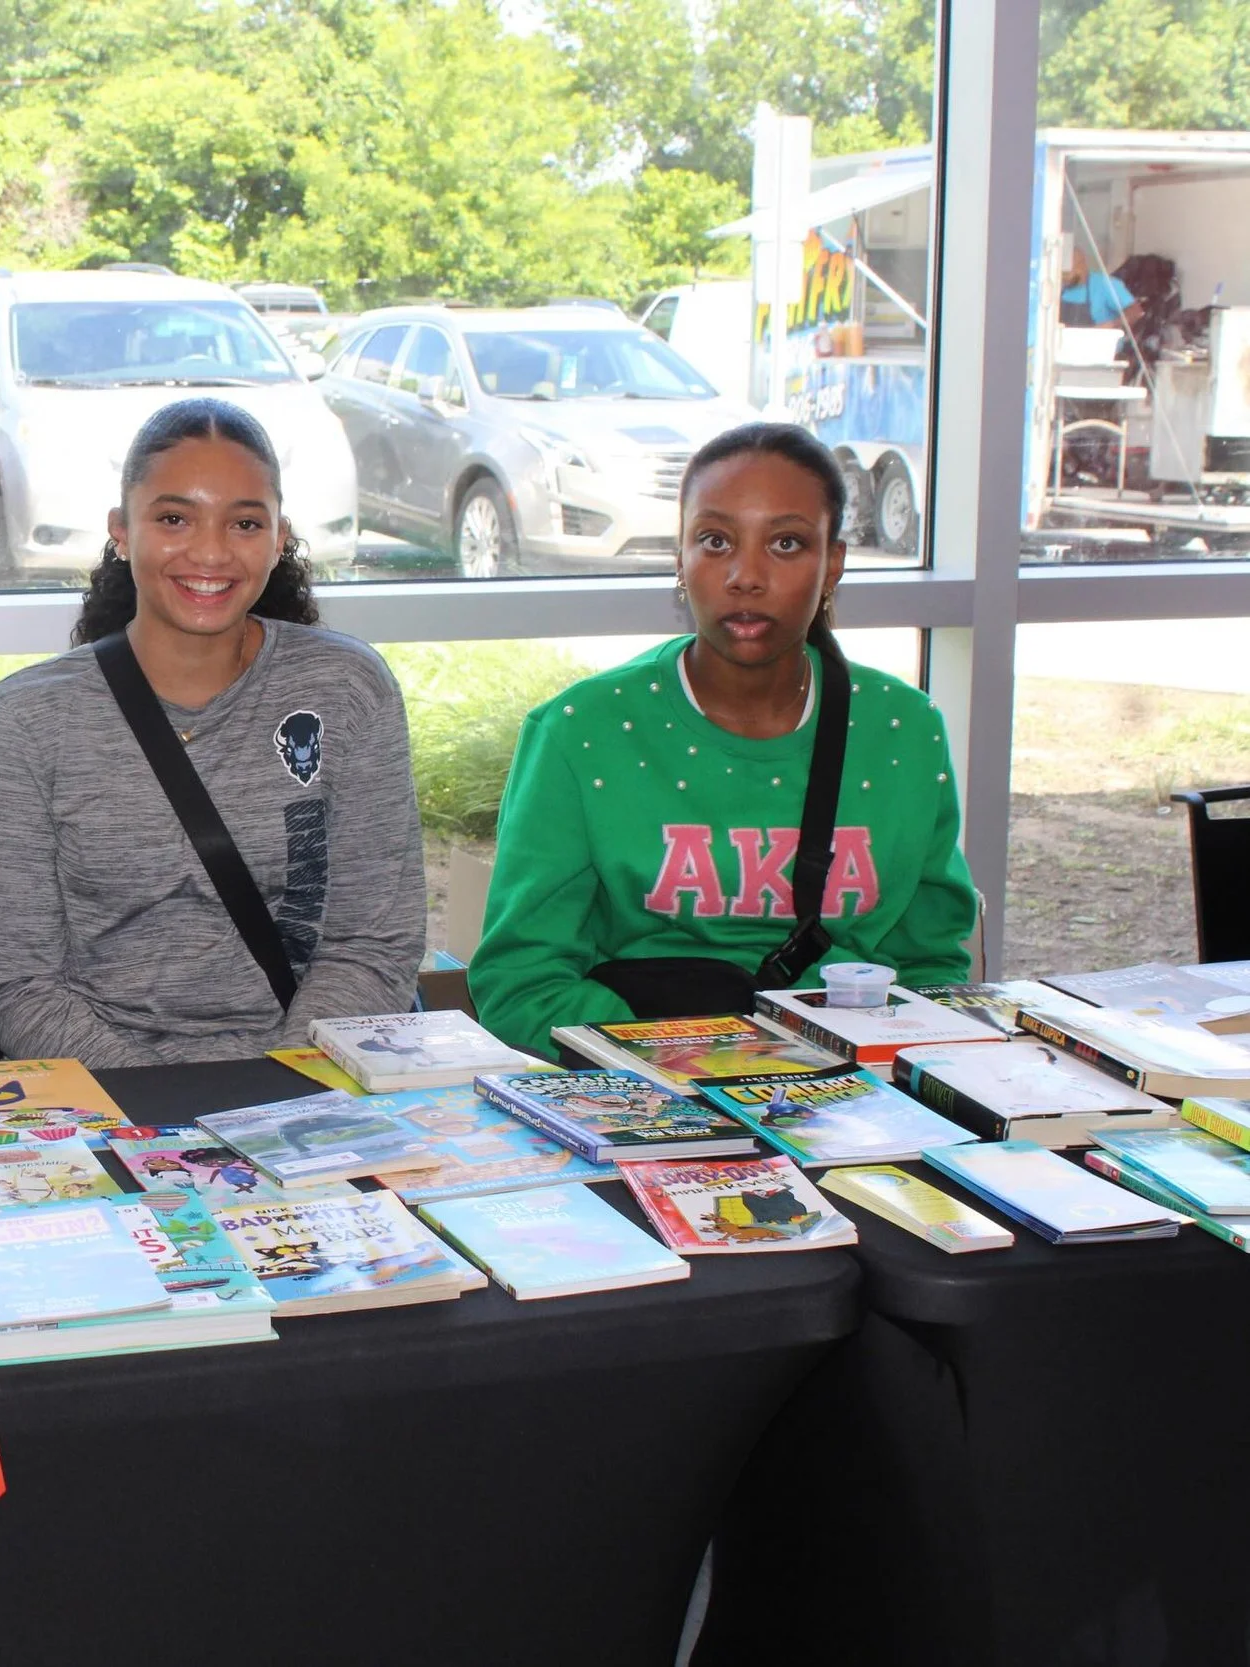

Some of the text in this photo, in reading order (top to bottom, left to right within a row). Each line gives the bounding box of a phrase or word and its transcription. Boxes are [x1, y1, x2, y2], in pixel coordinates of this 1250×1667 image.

[645, 824, 880, 919] AKA
[917, 987, 956, 996] MIKE
[349, 1016, 418, 1027] Wimpy
[611, 1020, 744, 1040] WOULD WIN?
[1020, 1012, 1066, 1048] MIKE LUPICA
[722, 1075, 866, 1104] COMEBACK
[1187, 1105, 1243, 1142] JOHN GRISHAM
[219, 1201, 382, 1232] BAD KITTY
[255, 1206, 290, 1215] NICK
[31, 1215, 102, 1236] WIN?
[272, 1221, 349, 1237] Meets
[320, 1220, 395, 1243] BABY
